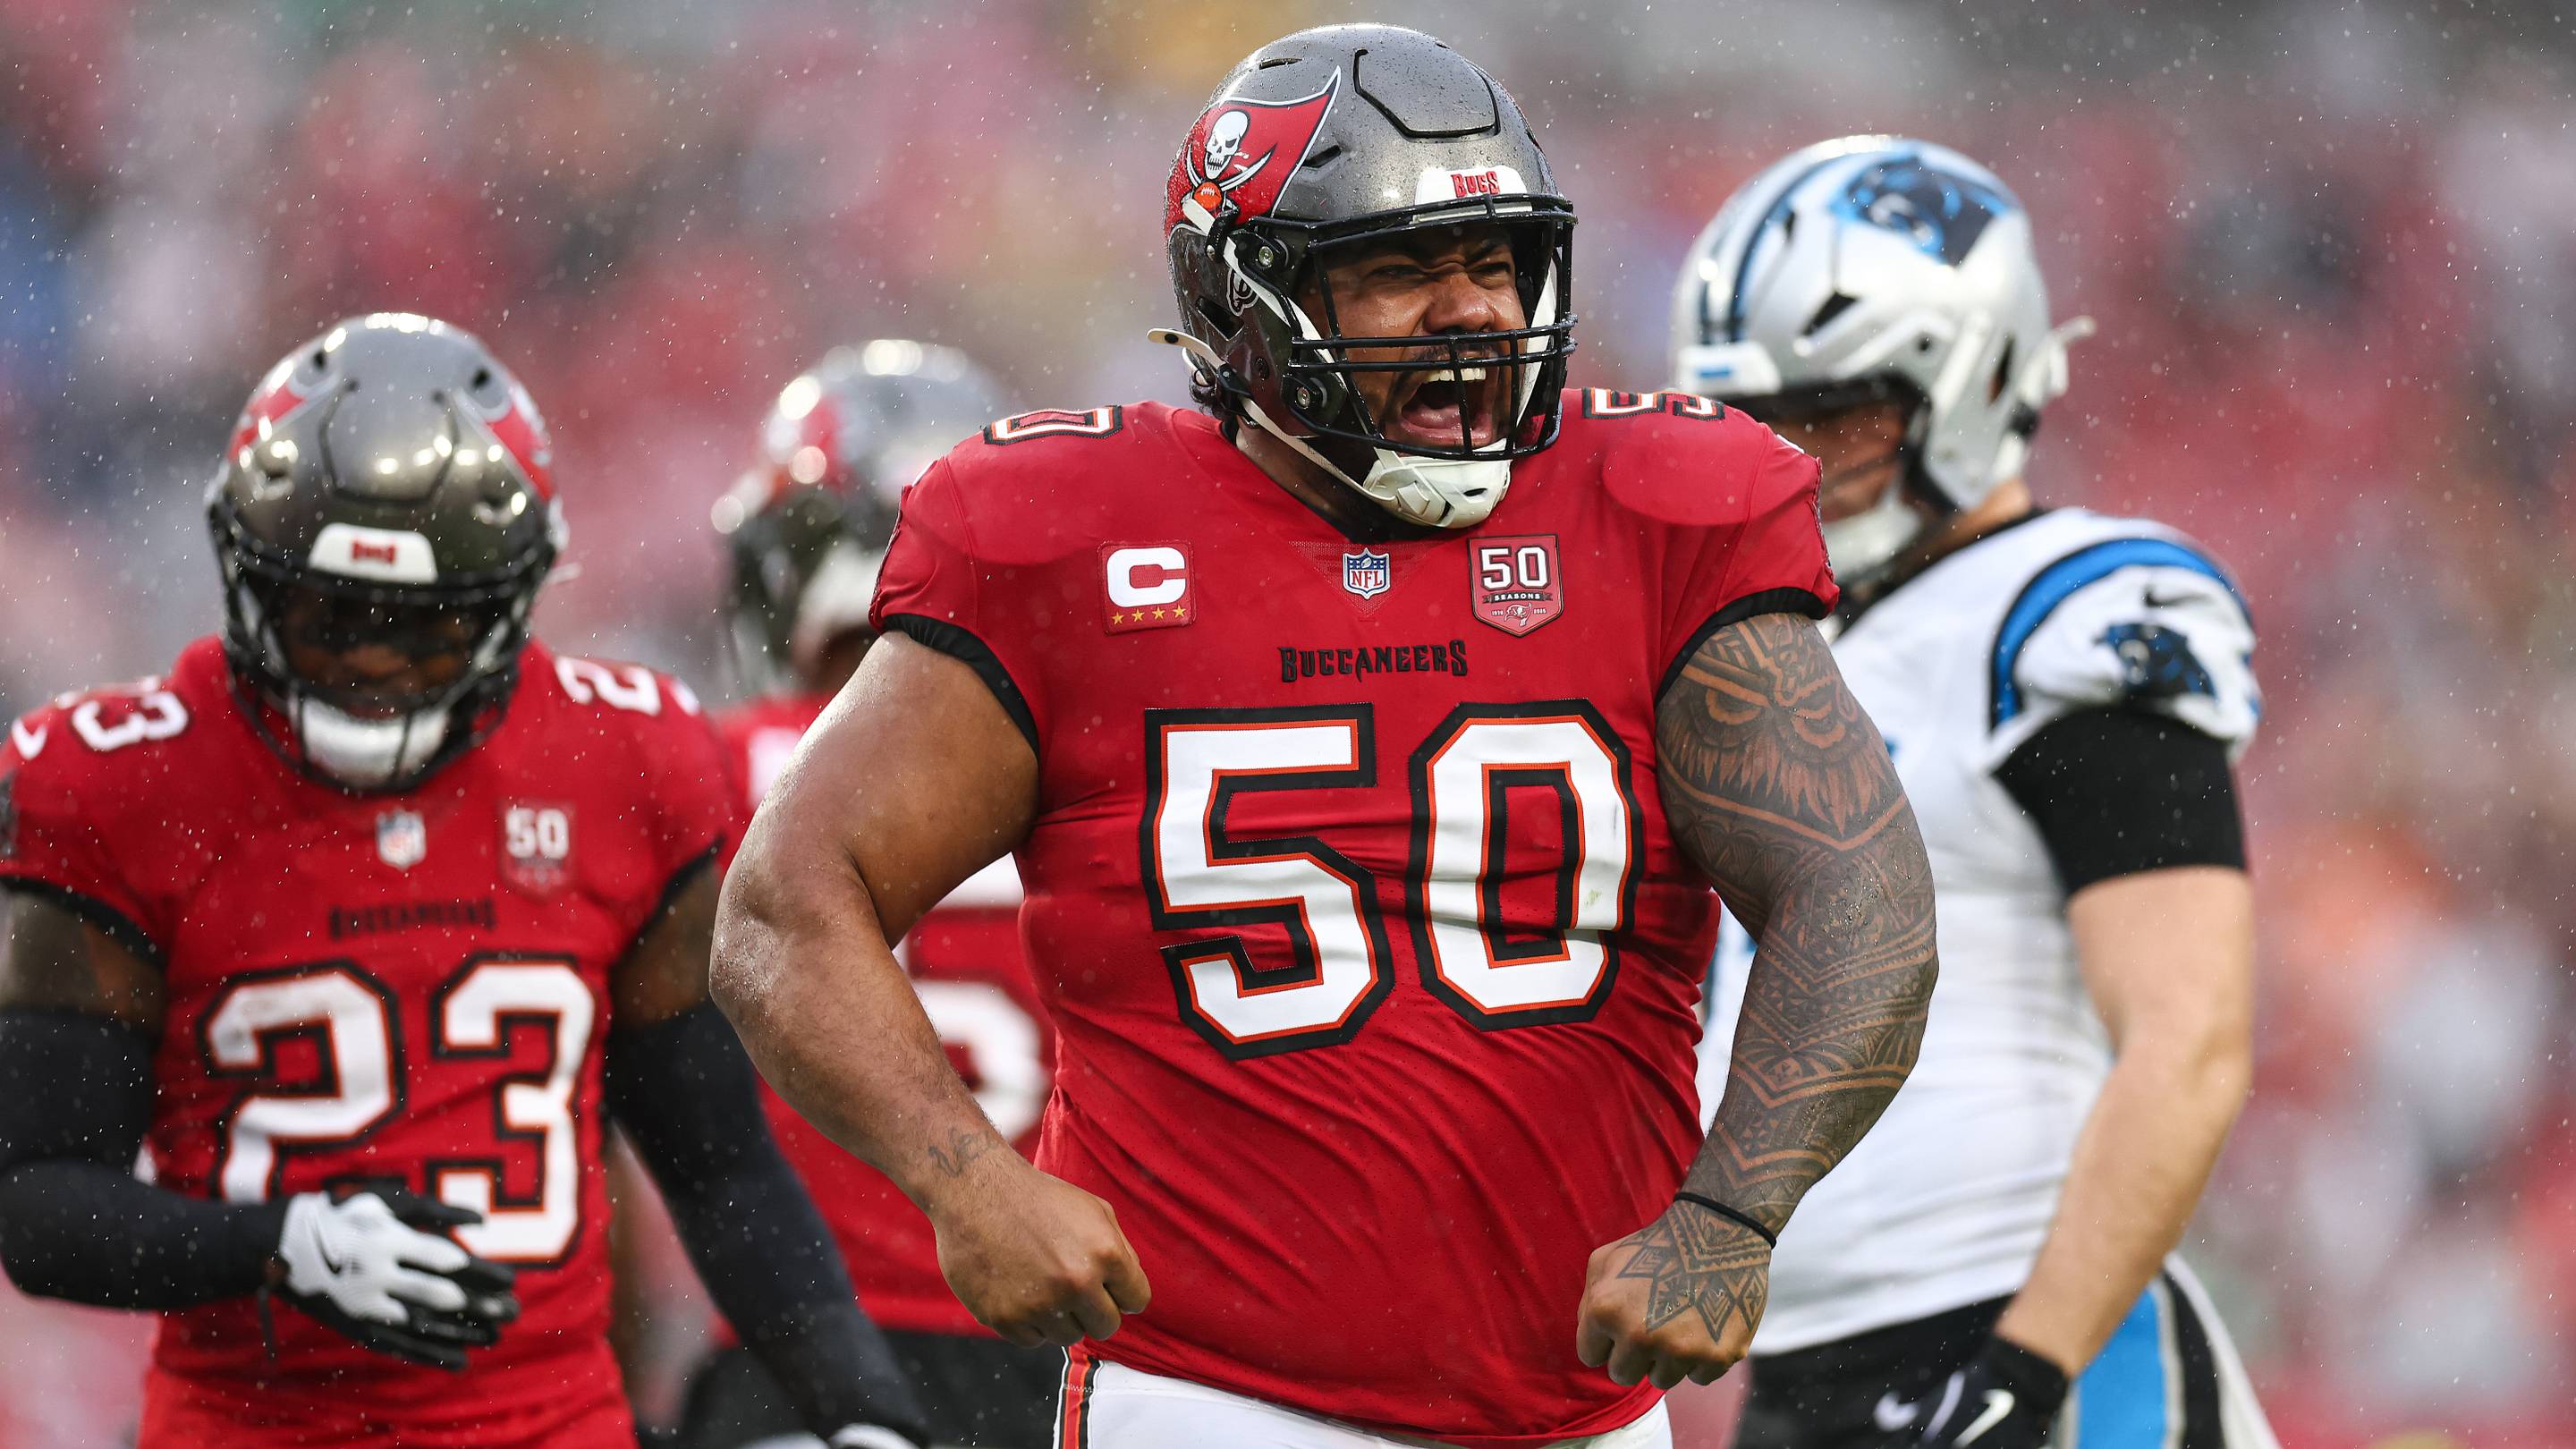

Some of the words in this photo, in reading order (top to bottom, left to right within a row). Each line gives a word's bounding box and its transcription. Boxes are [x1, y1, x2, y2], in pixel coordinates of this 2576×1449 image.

[1450, 171, 1500, 198] BUCS
[1106, 547, 1187, 607] C
[1352, 571, 1383, 589] NFL
[1479, 546, 1550, 589] 50
[1494, 592, 1541, 602] SEASONS
[1280, 640, 1468, 682] BUCCANEERS
[505, 808, 569, 860] 50
[1140, 698, 1644, 1061] 50
[199, 953, 597, 1268] 23
